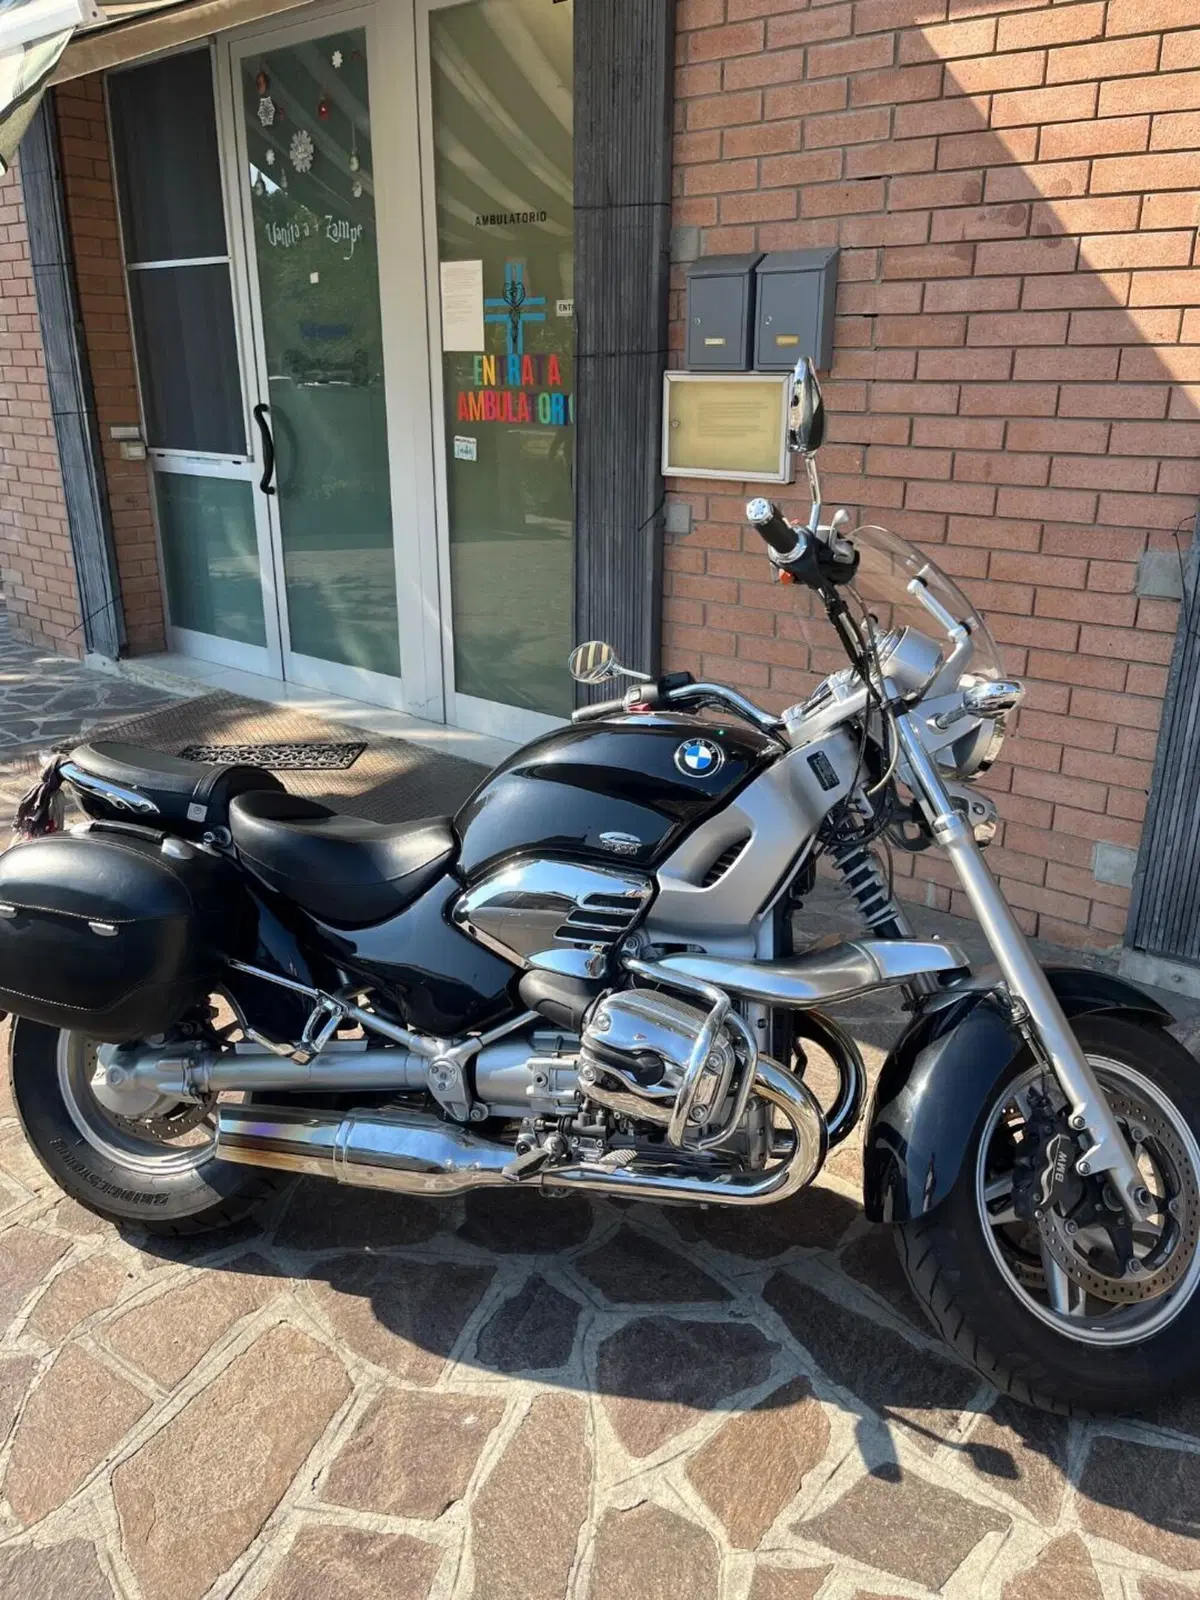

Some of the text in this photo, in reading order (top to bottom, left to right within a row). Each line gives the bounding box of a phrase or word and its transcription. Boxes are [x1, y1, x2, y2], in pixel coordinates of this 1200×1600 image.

[475, 211, 547, 226] AMBULATORIO
[473, 353, 562, 387] ENTRATA
[1055, 1151, 1068, 1182] BMW
